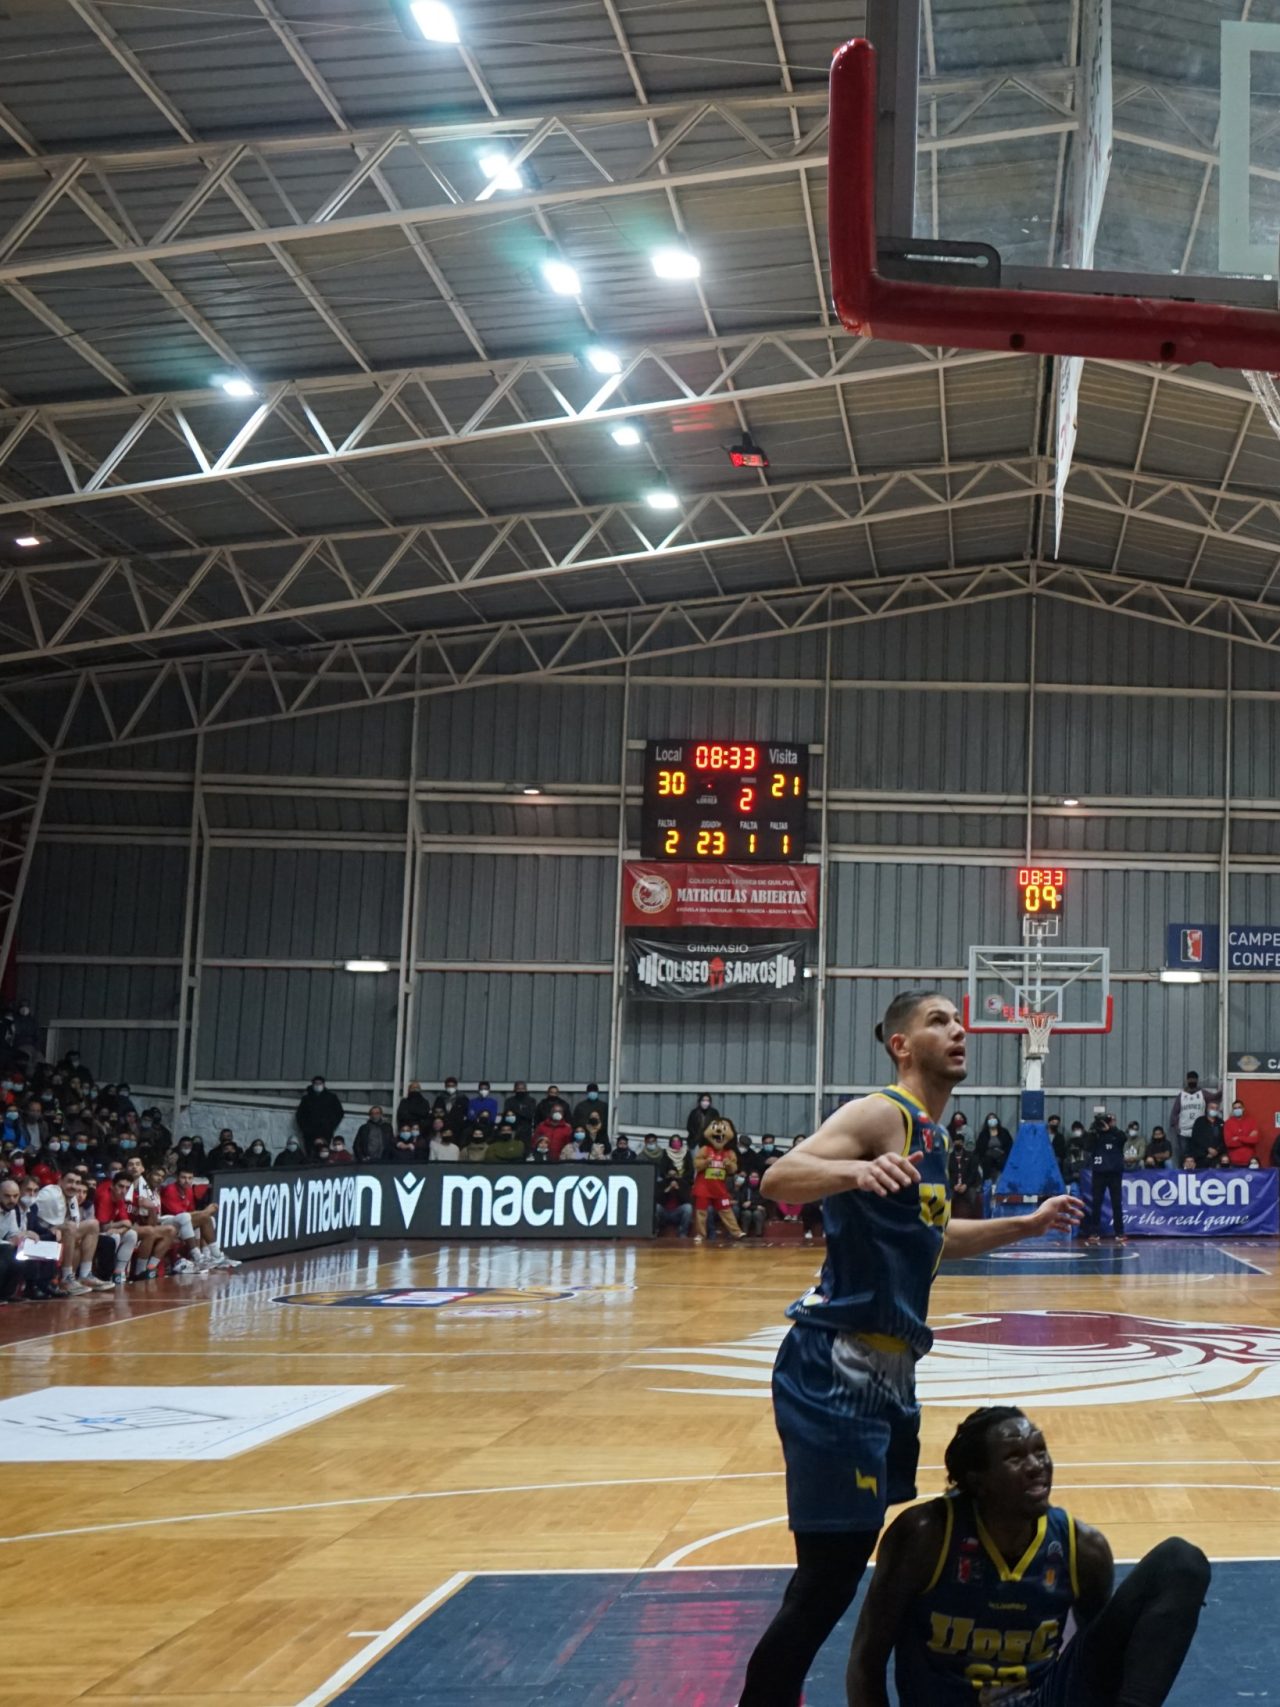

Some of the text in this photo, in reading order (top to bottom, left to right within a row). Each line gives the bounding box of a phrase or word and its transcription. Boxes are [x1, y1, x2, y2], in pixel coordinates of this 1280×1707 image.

[655, 746, 798, 769] Local 08:33 Visita
[658, 771, 800, 797] 30 21
[740, 788, 753, 811] 2
[740, 821, 758, 830] FALTA
[666, 830, 788, 854] 2 23 1 1
[1019, 870, 1063, 885] 08:33
[677, 886, 807, 904] MATRÍCULAS ABIERTAS
[1025, 885, 1056, 911] 09
[687, 944, 749, 953] GIMNASIO
[657, 959, 777, 983] COLISEO SARKOS
[1122, 1174, 1249, 1207] molten
[218, 1182, 289, 1248] macron
[440, 1175, 639, 1227] macron
[1139, 1210, 1166, 1226] the
[1167, 1210, 1204, 1226] real
[1203, 1213, 1249, 1231] game
